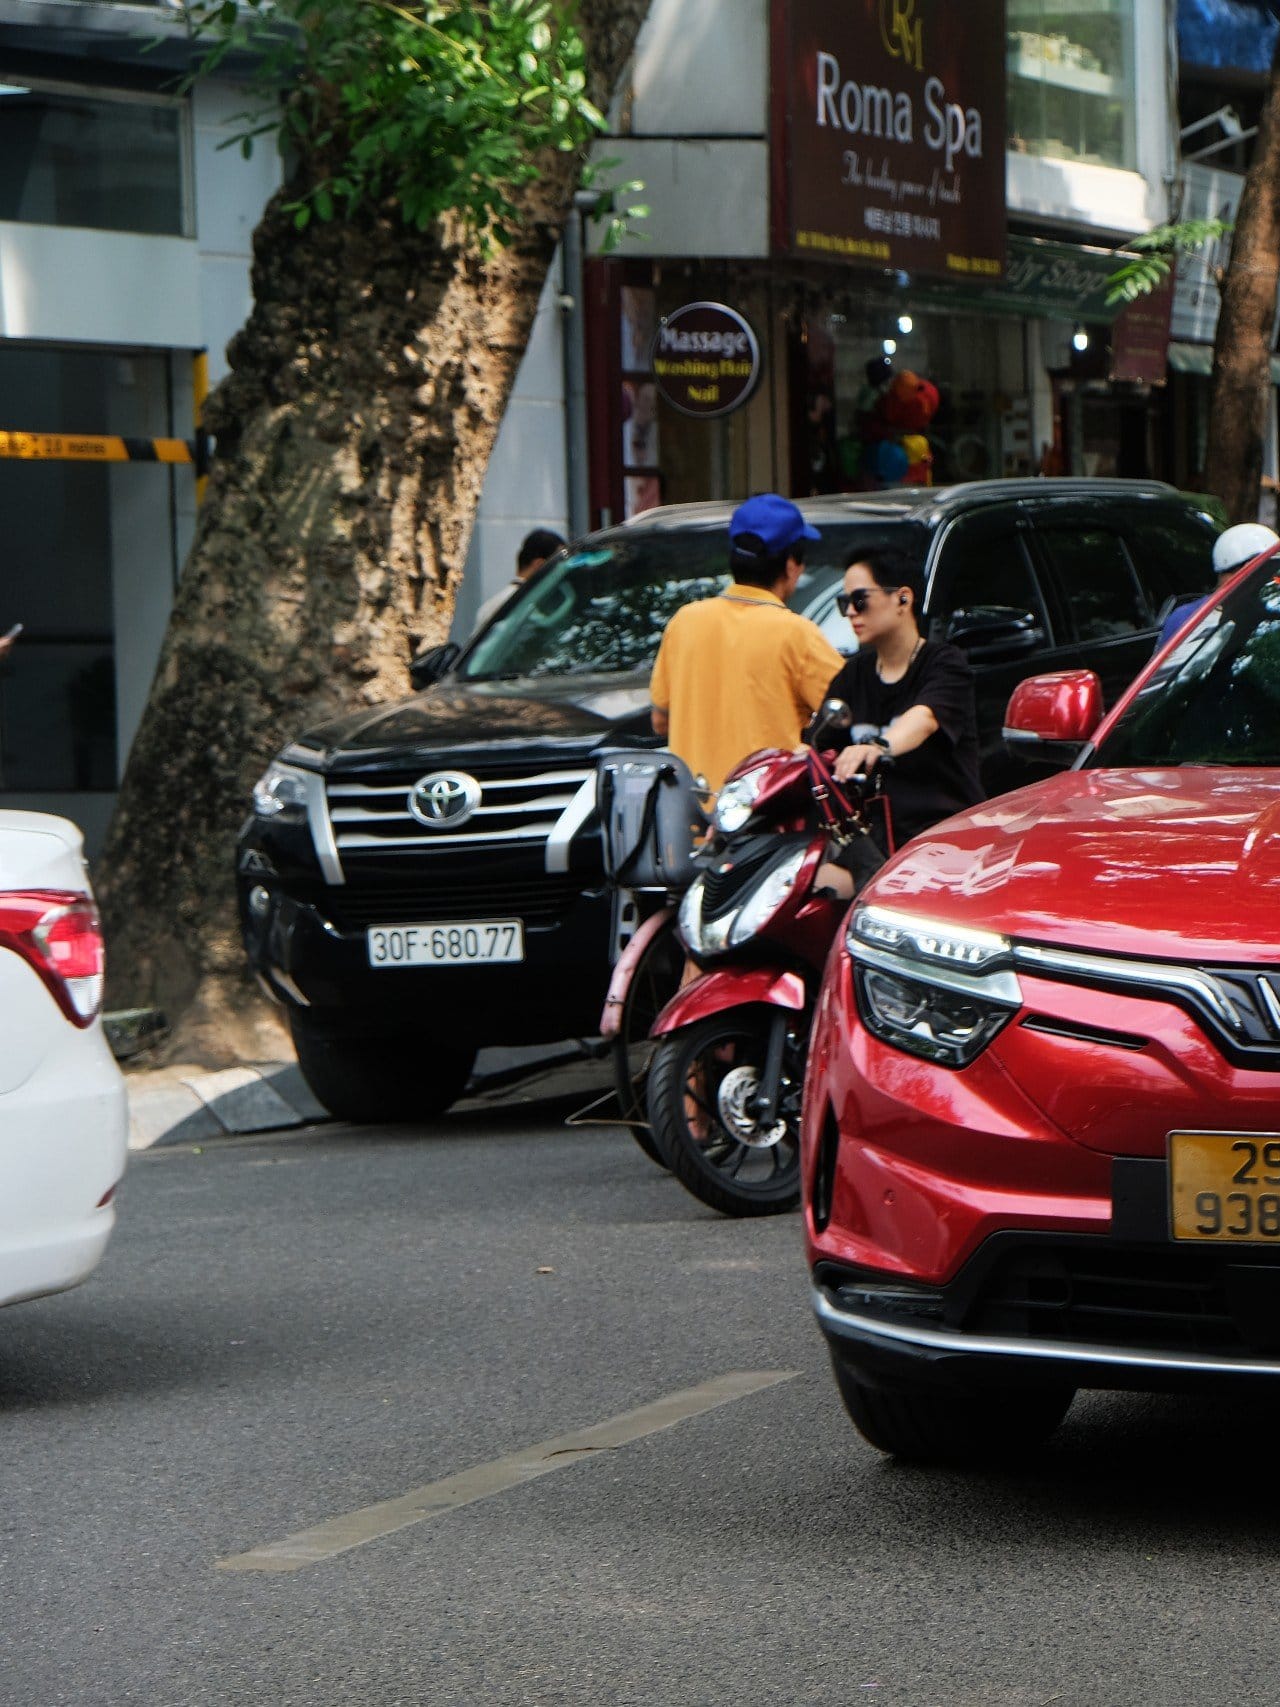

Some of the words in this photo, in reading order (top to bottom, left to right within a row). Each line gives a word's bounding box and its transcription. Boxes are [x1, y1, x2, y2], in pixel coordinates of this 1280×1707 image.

[816, 50, 914, 143] Roma
[923, 76, 983, 173] Spa
[660, 327, 748, 358] Massage
[687, 384, 720, 402] Nail
